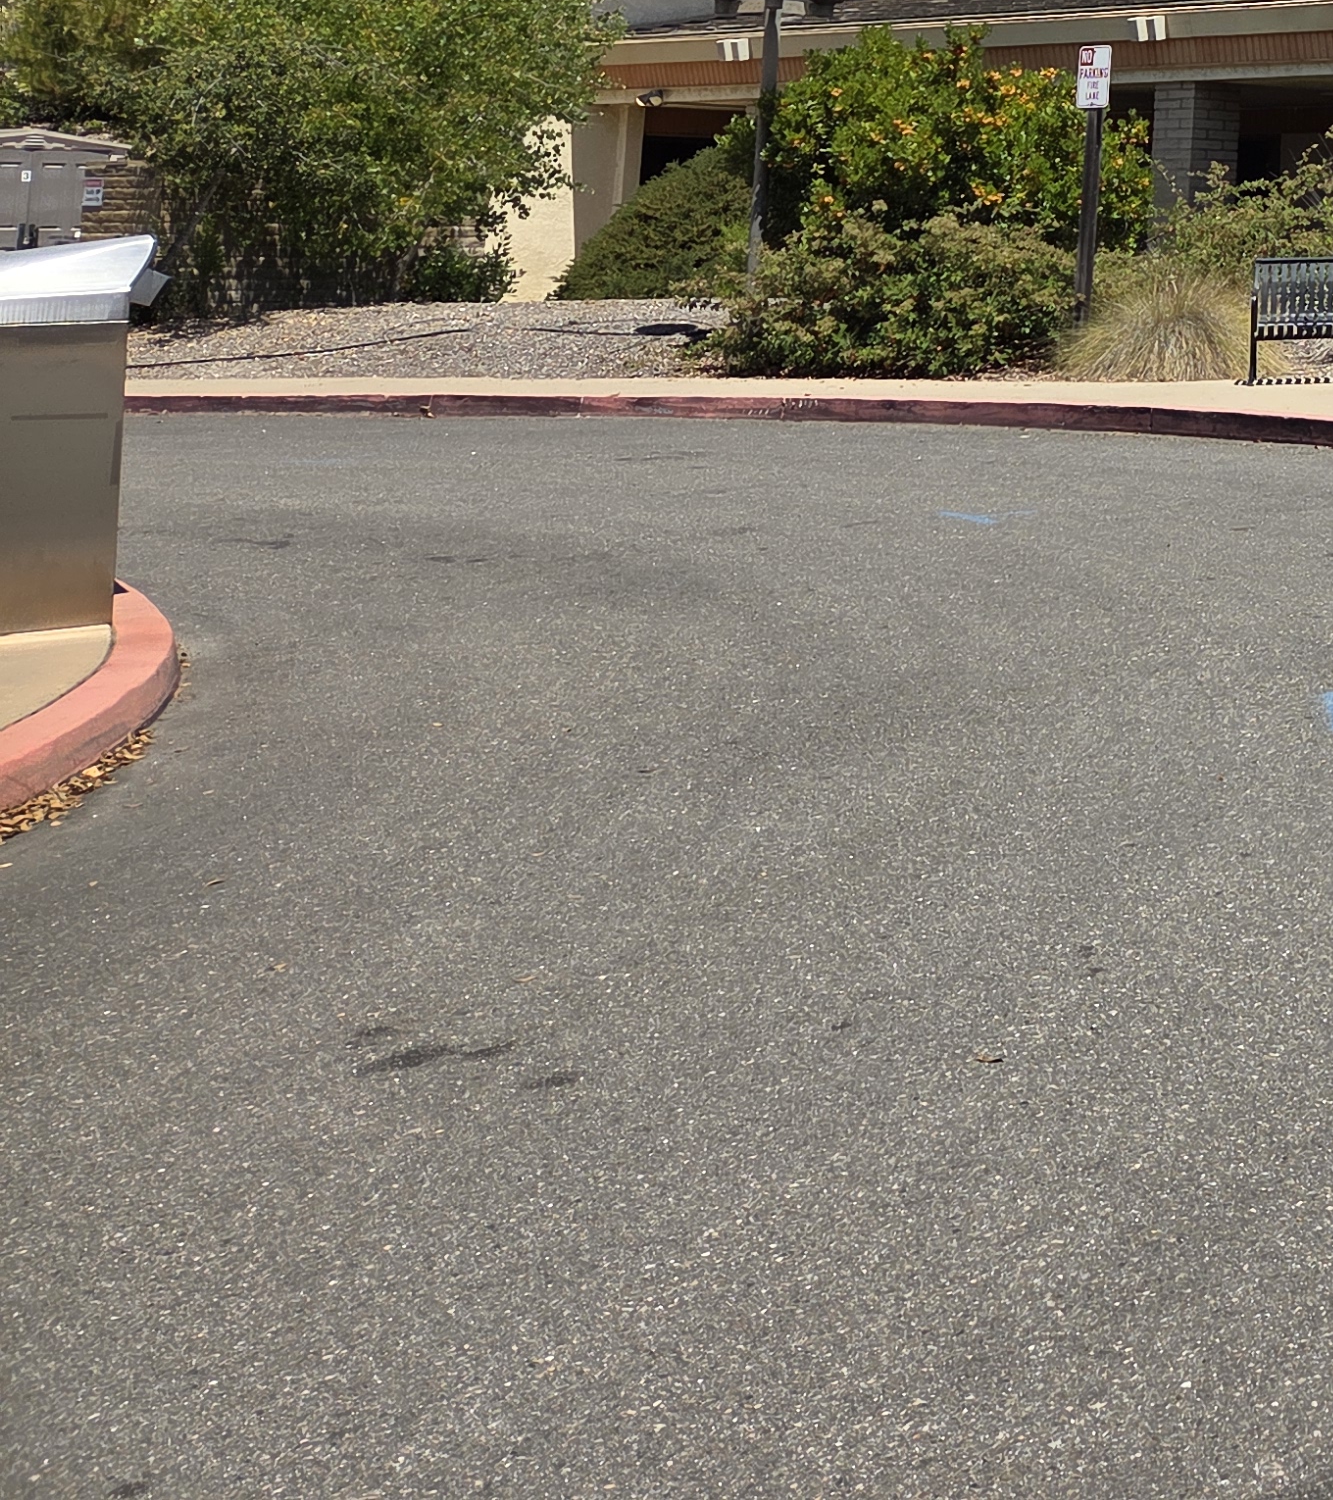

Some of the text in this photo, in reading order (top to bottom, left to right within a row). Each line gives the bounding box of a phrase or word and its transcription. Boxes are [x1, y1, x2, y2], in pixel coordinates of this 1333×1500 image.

[1081, 50, 1093, 64] NO
[1079, 67, 1109, 79] PARKING
[1085, 91, 1099, 100] LANE
